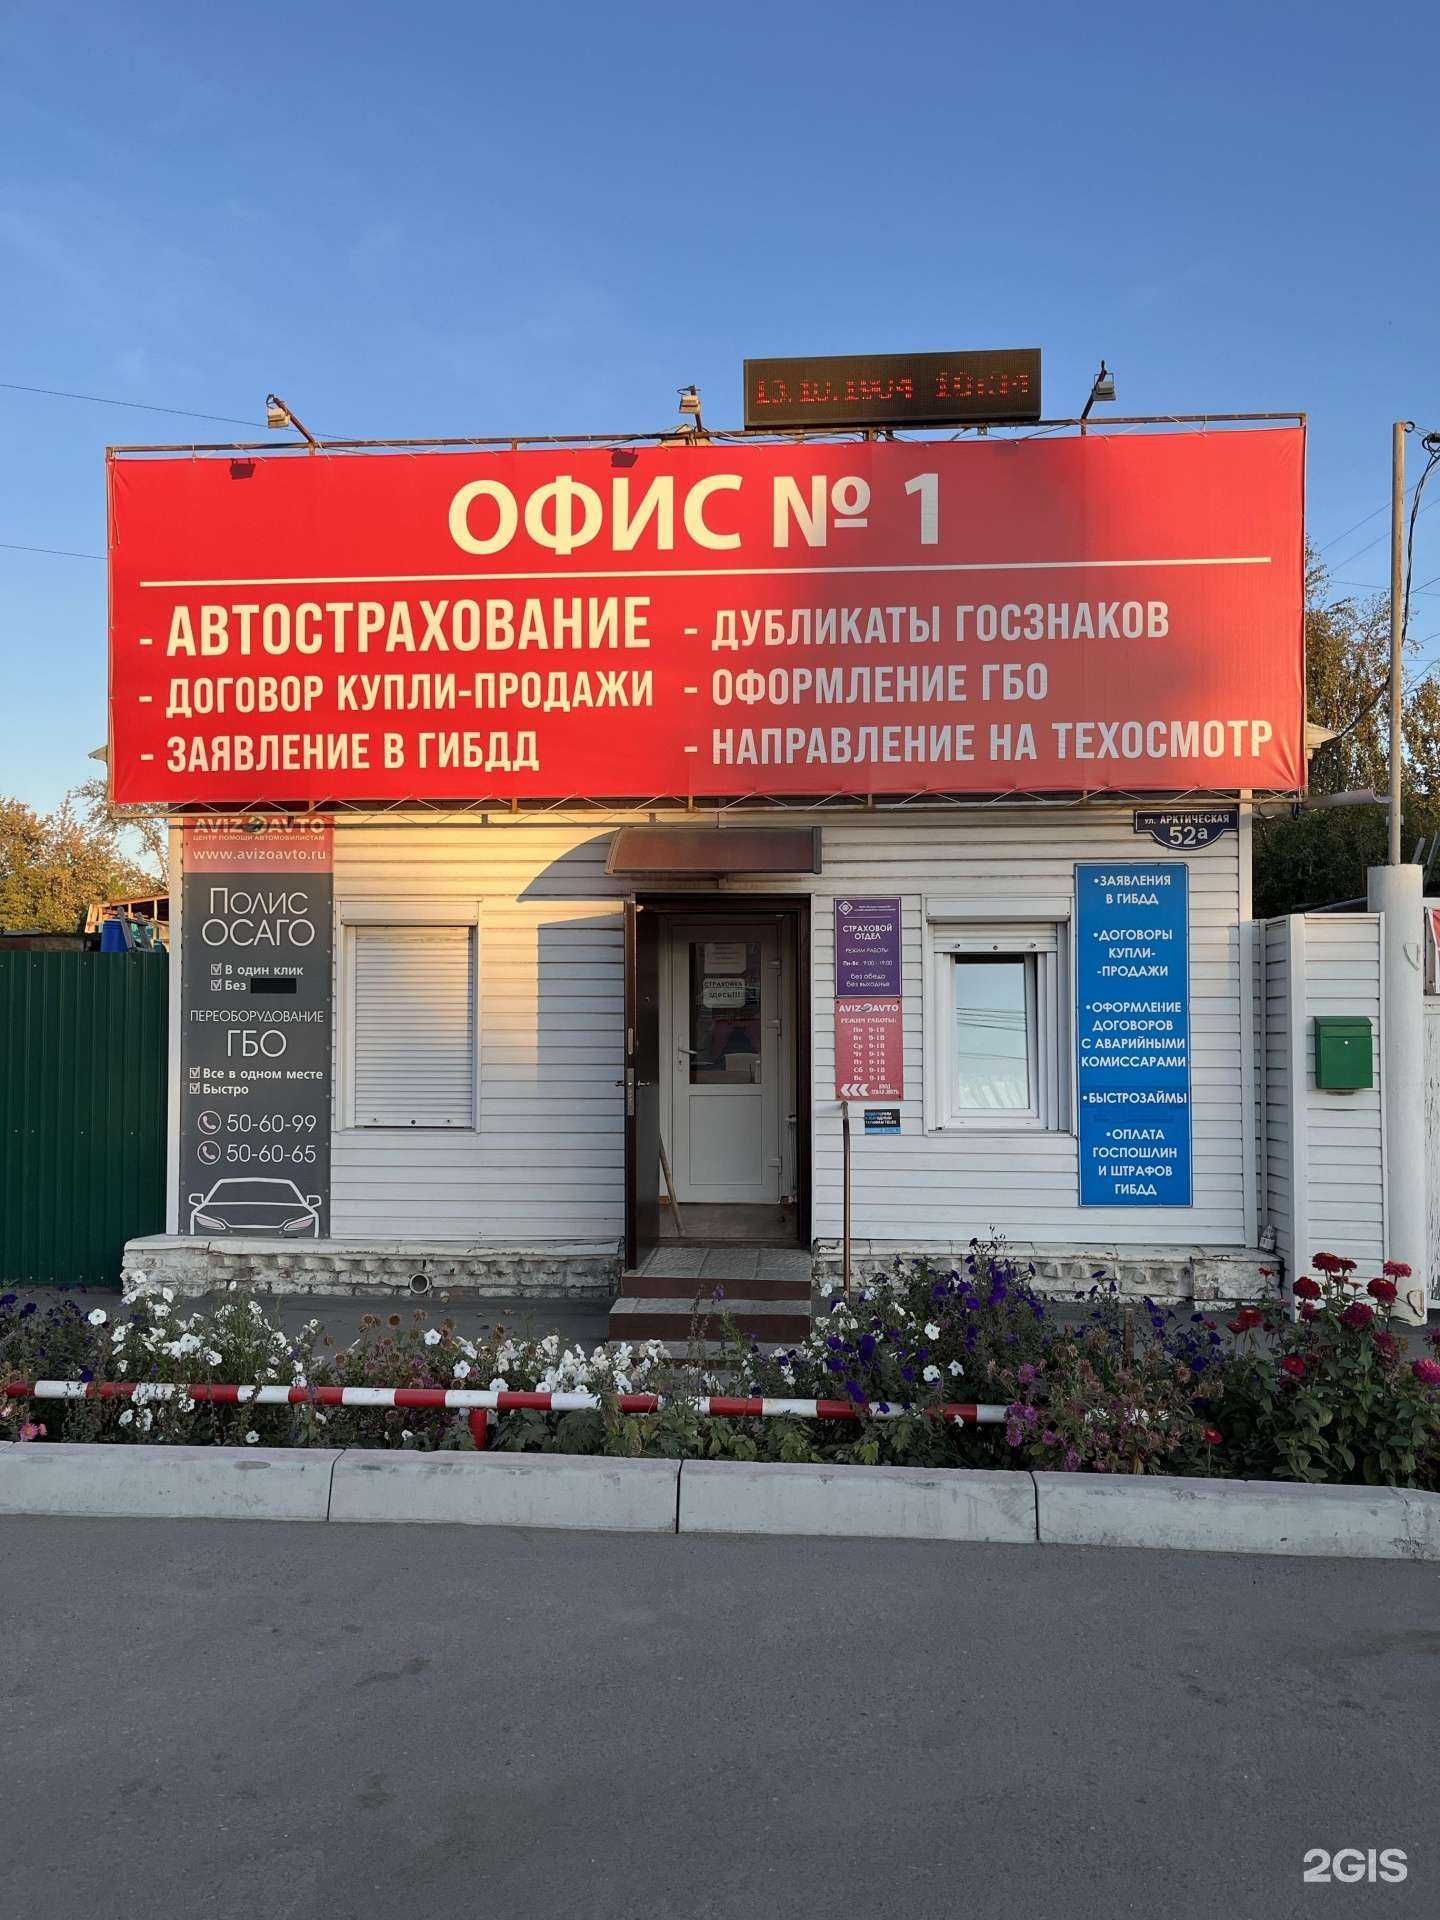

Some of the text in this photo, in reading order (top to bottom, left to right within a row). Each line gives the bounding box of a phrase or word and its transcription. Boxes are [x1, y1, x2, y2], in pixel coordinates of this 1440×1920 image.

[448, 473, 939, 556] ОФИС № 1
[166, 596, 651, 657] АВТОСТРАХОВАНИЕ
[711, 601, 1169, 652] ДУБЛИКАТЫ ГОСЗНАКОВ
[711, 663, 1048, 706] ОФОРМЛЕНИЕ ГБО
[165, 670, 653, 719] ДОГОВОР КУПЛИ-ПРОДАЖИ
[712, 720, 1273, 764] НАПРАВЛЕНИЕ НА ТЕХОСМОТР
[166, 731, 539, 773] ЗАЯВЛЕНИЕ В ГИБДД
[1160, 814, 1230, 824] АРКТИЧЕСКАЯ
[1169, 826, 1208, 845] 52а
[193, 848, 326, 860] www.avizoavto.ru
[1100, 875, 1171, 886] ЗАЯВЛЕНИЯ
[210, 887, 309, 915] ПОЛИС
[1106, 893, 1159, 905] В ГИБДД
[202, 919, 315, 946] ОСАГО
[842, 924, 893, 932] СТРАХОВОЙ
[1099, 929, 1173, 941] ДОГОВОРЫ
[1108, 948, 1156, 959] КУПЛИ-
[225, 965, 304, 976] В один клик
[1097, 966, 1168, 978] -ПРОДАЖИ
[225, 980, 247, 991] Без
[1092, 1002, 1182, 1013] ОФОРМЛЕНИЕ
[190, 1010, 324, 1023] ПЕРЕОБОРУДОВАНИЕ
[1092, 1020, 1173, 1032] ДОГОВОРОВ
[227, 1029, 287, 1058] ГБО
[1081, 1036, 1185, 1049] С АВАРИЙНЫМИ
[1081, 1056, 1186, 1068] КОМИССАРАМИ
[203, 1068, 324, 1080] Все в одном месте
[203, 1084, 249, 1096] Быстро
[1089, 1090, 1187, 1104] БЫСТРОЗАЙМЫ
[226, 1114, 317, 1133] 50-60-99
[1112, 1129, 1165, 1140] ОПЛАТА
[226, 1144, 317, 1163] 50-60-65
[1092, 1147, 1177, 1159] ГОСПОШЛИН
[1098, 1165, 1173, 1177] И ШТРАФОВ
[1114, 1184, 1157, 1195] ГИБДД
